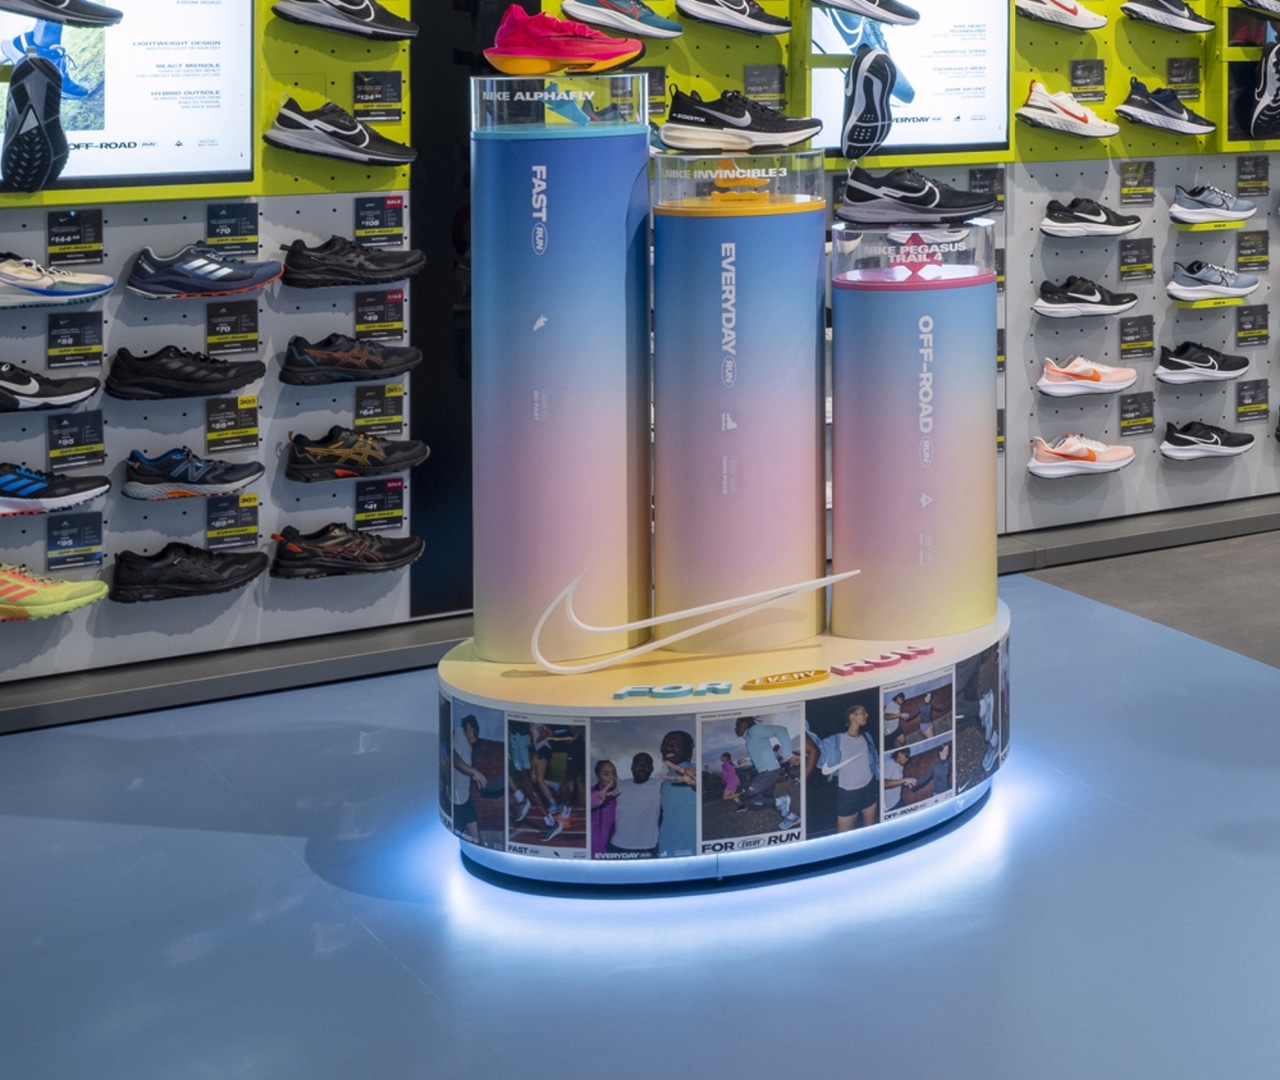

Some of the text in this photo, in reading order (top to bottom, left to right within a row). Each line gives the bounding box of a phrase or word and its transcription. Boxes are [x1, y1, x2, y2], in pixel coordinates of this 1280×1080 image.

[482, 91, 595, 101] NIKE ALPHAFLY
[891, 115, 930, 123] VERYDAY
[68, 142, 137, 150] OFF-ROAD
[666, 167, 788, 179] NIKE INVINCIBLE 3
[531, 165, 547, 222] FAST
[535, 226, 544, 251] RUN
[864, 242, 966, 255] NIKE PEGASUS
[888, 252, 943, 263] TRAIL 4
[721, 242, 737, 355] EVERYDAY
[725, 360, 733, 385] RUN
[918, 314, 935, 434] OFF-ROAD
[922, 440, 931, 464] RUN
[612, 644, 934, 700] FOR EVERY RUN
[883, 804, 920, 821] OFF-ROAD
[508, 844, 529, 854] FAST
[701, 831, 801, 854] FOR EVERY RUN
[595, 851, 639, 859] EVERYDAY
